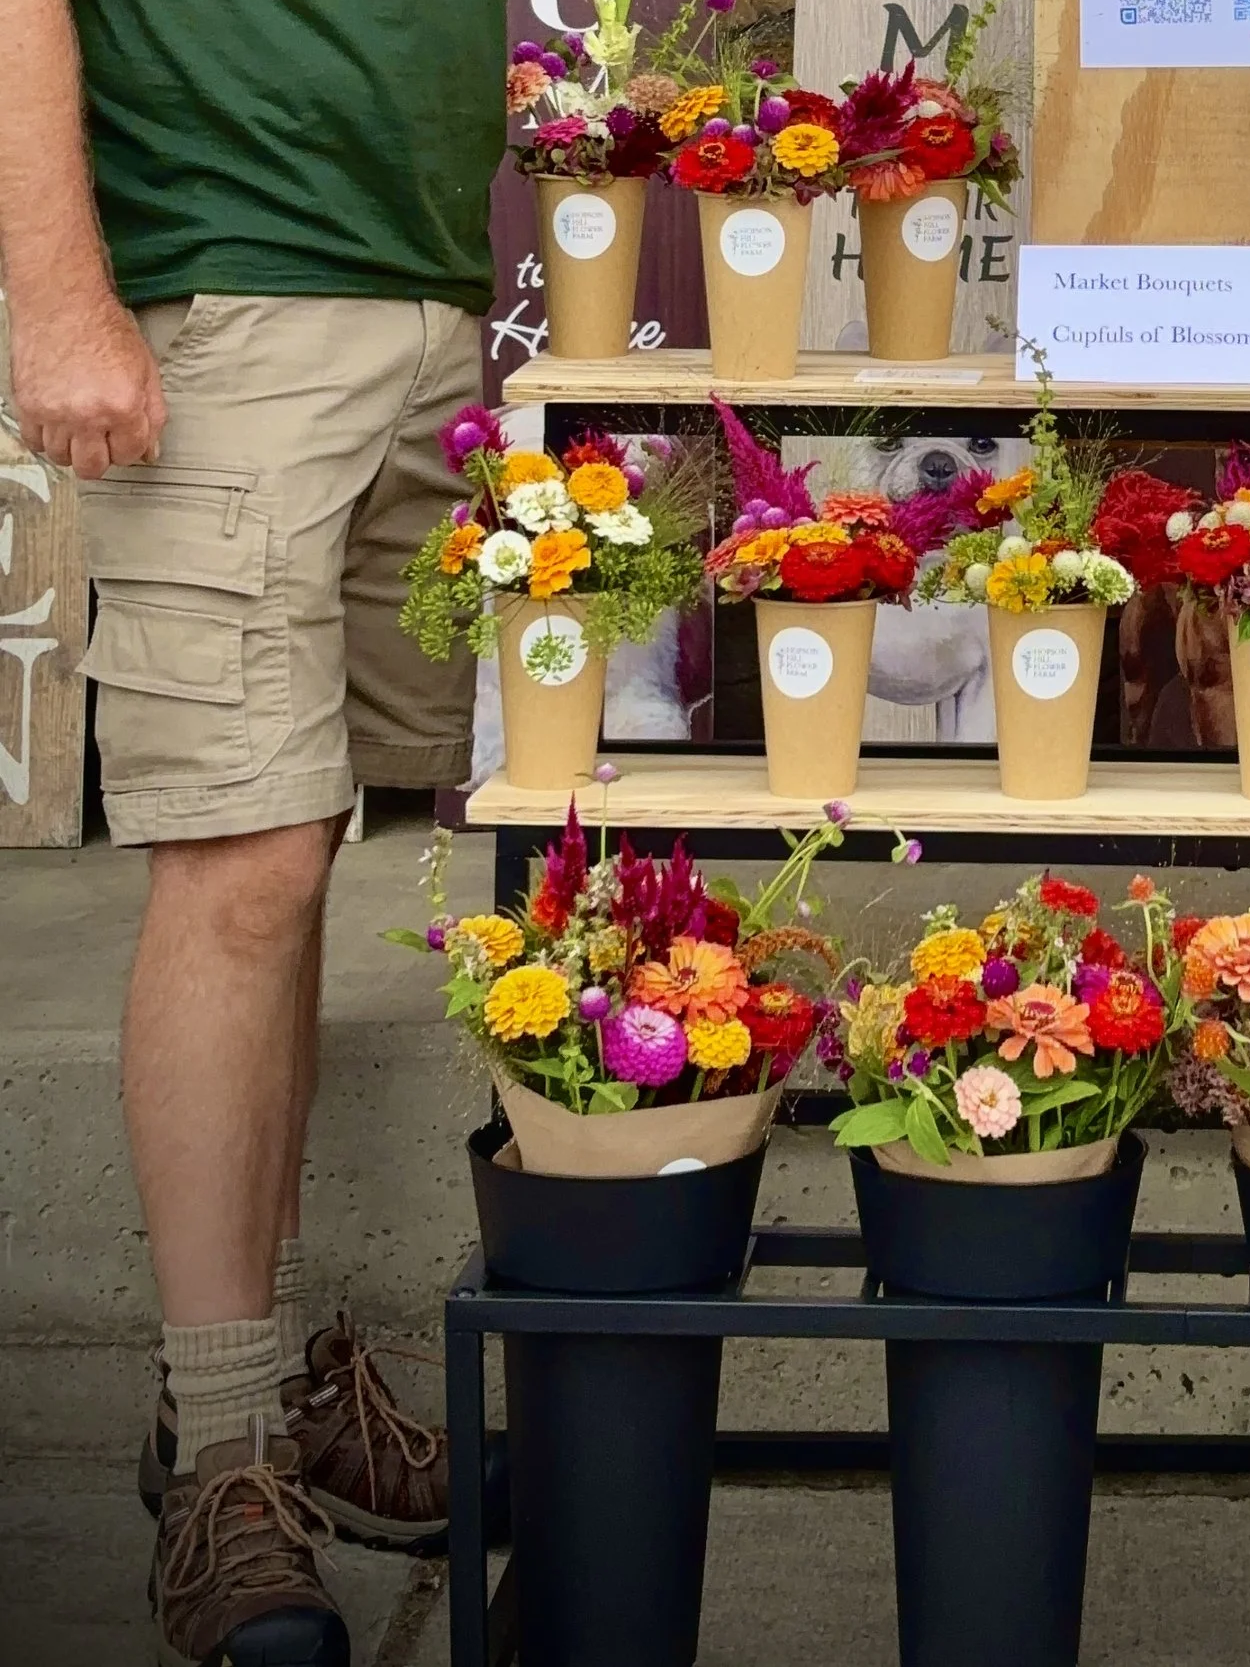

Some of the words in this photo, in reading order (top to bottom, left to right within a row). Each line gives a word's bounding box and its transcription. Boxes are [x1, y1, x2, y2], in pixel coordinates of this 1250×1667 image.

[1054, 272, 1128, 291] Market
[1137, 274, 1233, 297] Bouquets
[1052, 325, 1133, 348] Cupfuls
[1140, 326, 1163, 344] of
